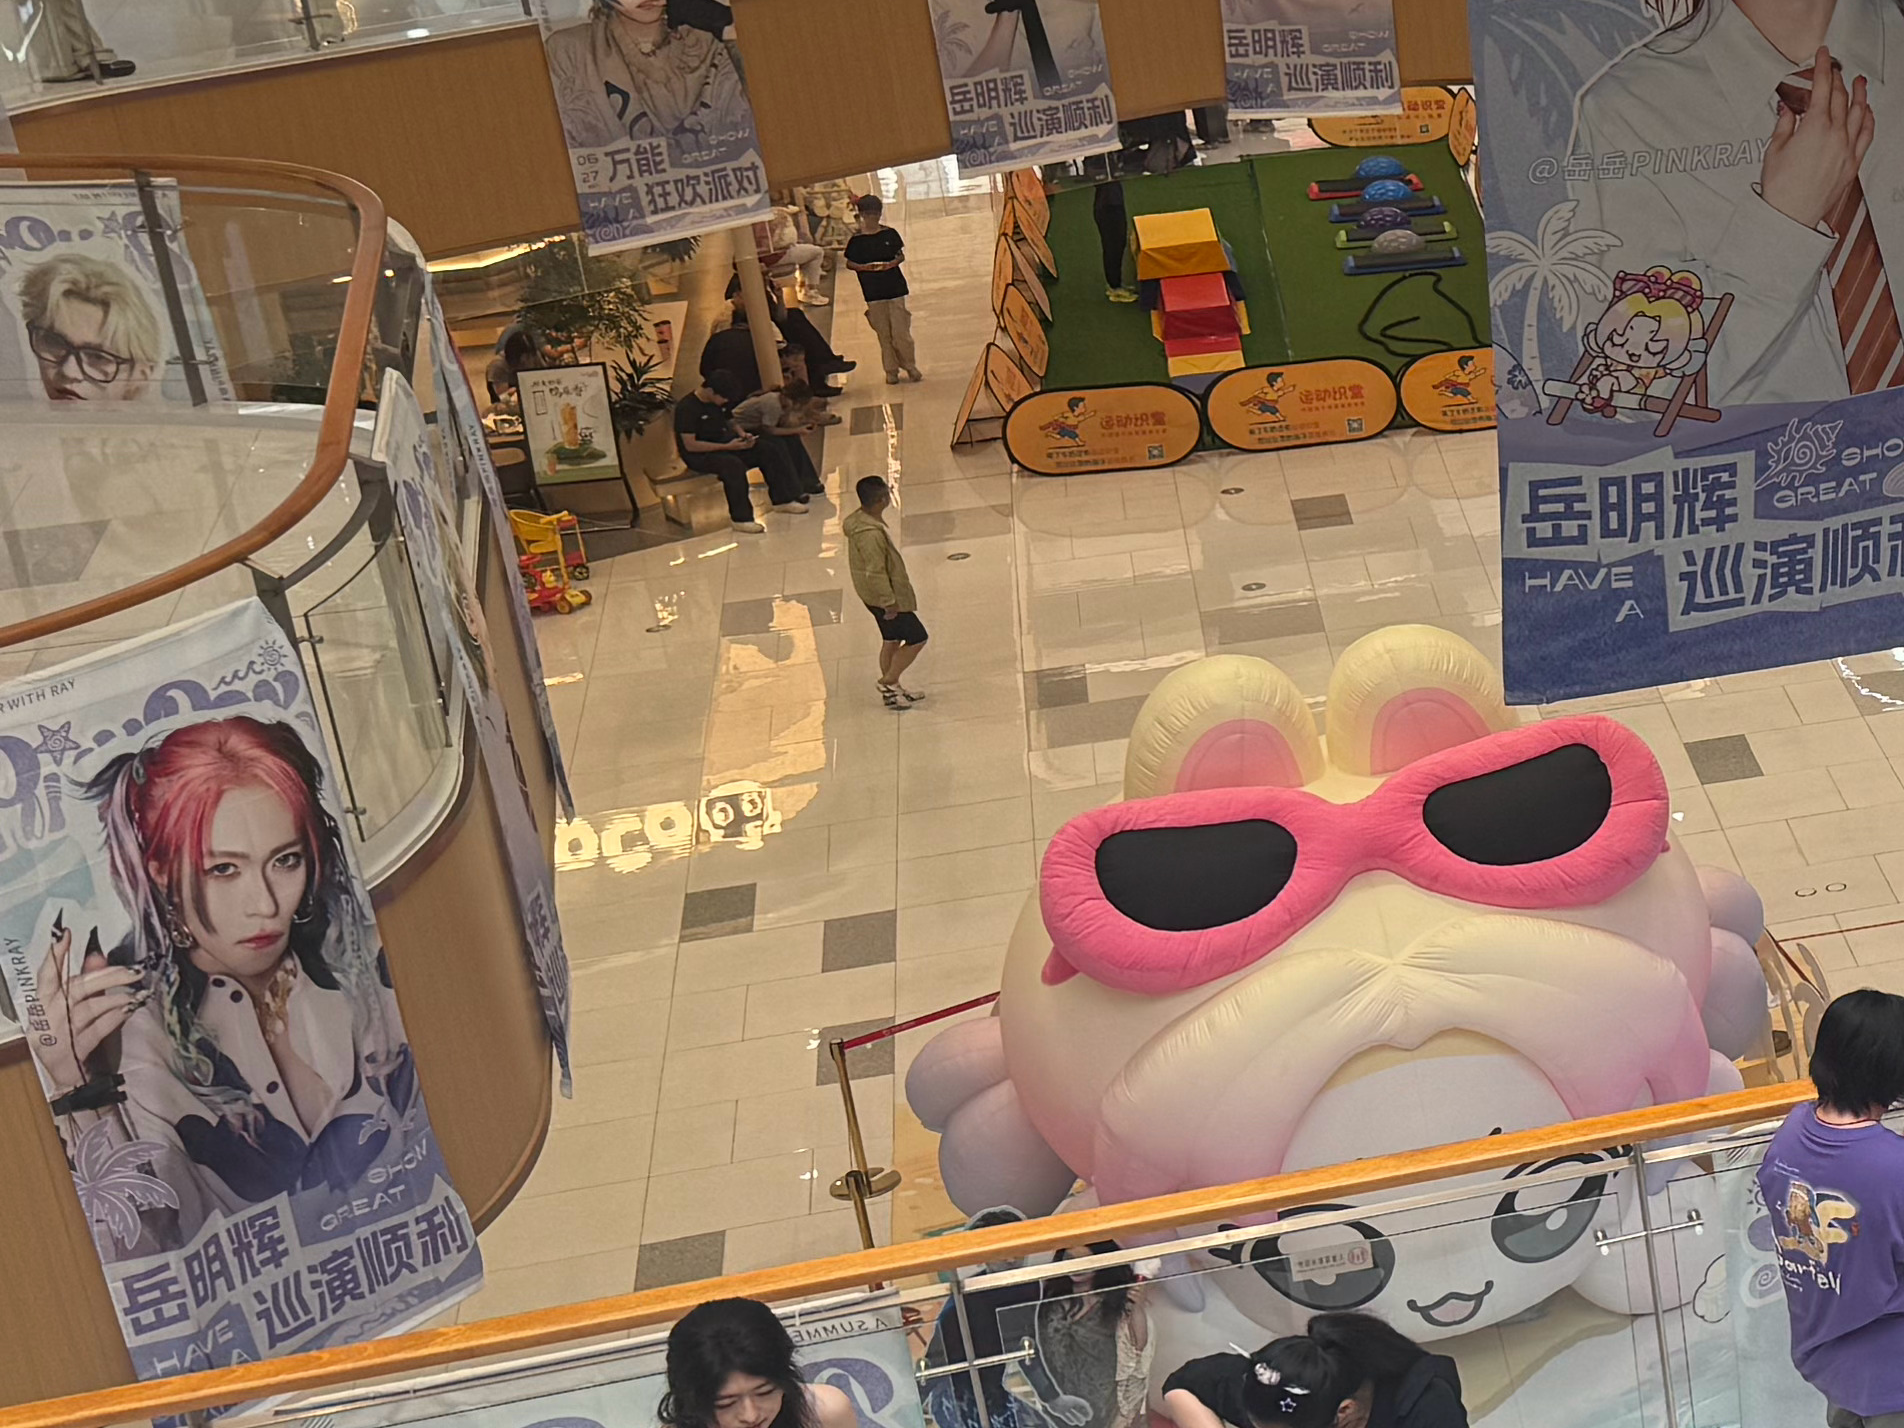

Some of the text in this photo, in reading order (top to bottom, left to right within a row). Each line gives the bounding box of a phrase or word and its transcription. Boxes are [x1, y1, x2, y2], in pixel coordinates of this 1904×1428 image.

[1226, 28, 1306, 59] 岳明辉
[948, 74, 1029, 117] 岳明辉
[1284, 60, 1395, 93] 巡演顺利
[1008, 94, 1114, 143] 巡演顺利
[577, 153, 599, 166] 06
[582, 170, 599, 184] 27
[604, 142, 668, 184] 万能
[1528, 137, 1774, 185] @岳岳PINKRAY
[645, 161, 762, 215] 狂欢派对
[1521, 461, 1739, 549] 岳明辉
[1773, 472, 1878, 508] GREAT
[1524, 566, 1634, 593] HAVE
[1615, 599, 1645, 623] A
[7, 677, 77, 716] WITH RAY
[367, 1140, 428, 1184] SHOW
[319, 1184, 406, 1231] GREAT
[123, 1205, 291, 1337] 岳明辉
[252, 1195, 470, 1350] 巡演顺利
[152, 1319, 234, 1376] HAVE
